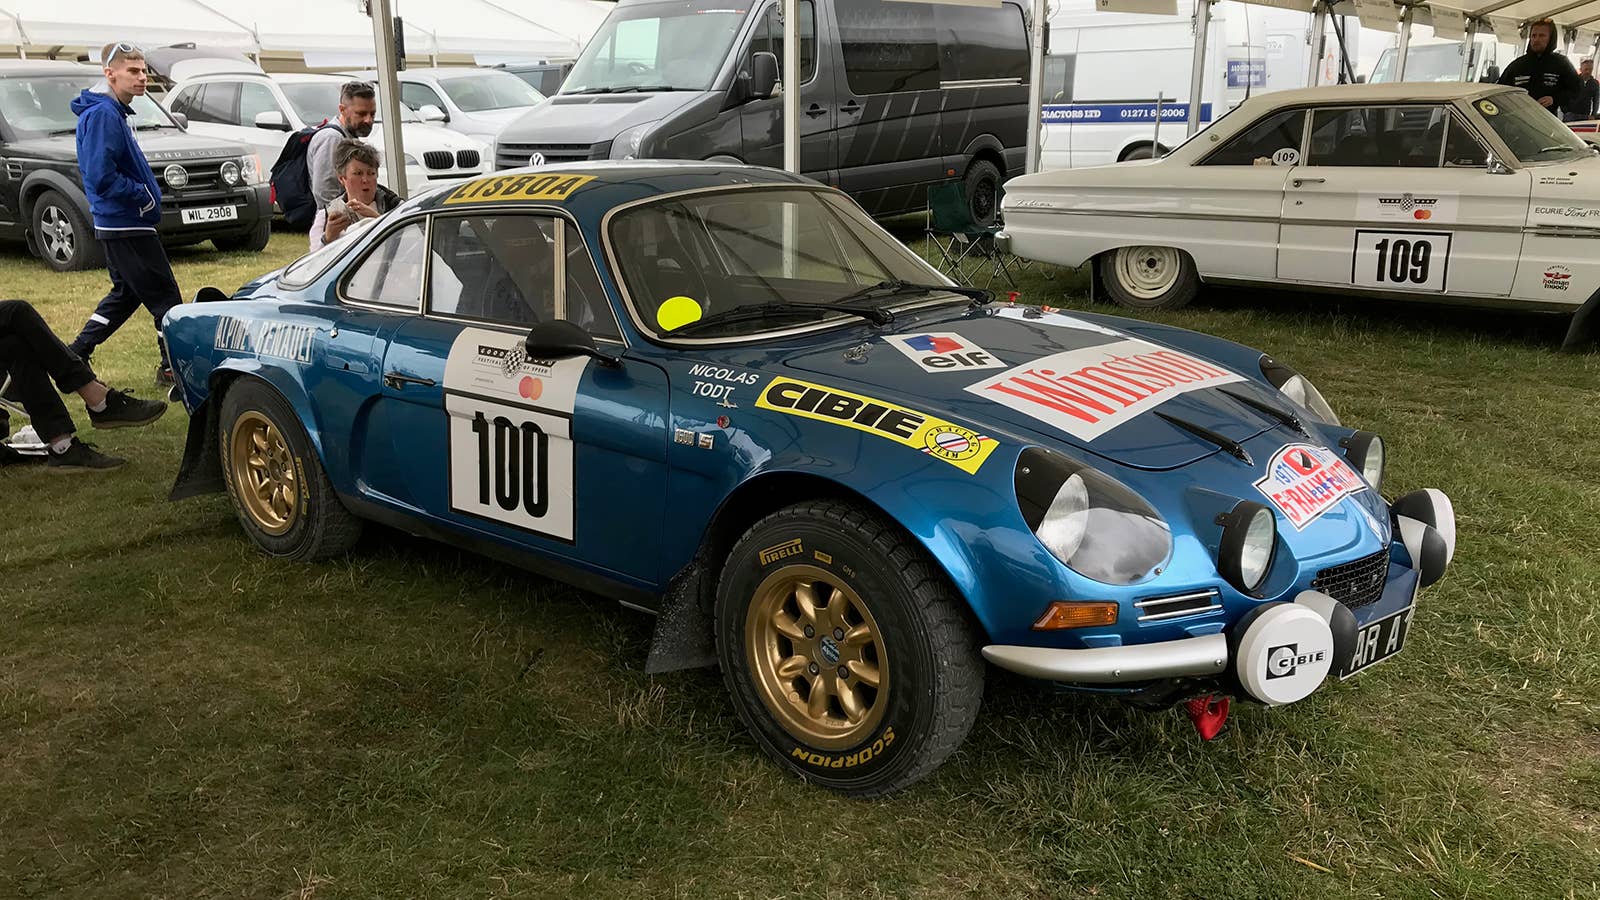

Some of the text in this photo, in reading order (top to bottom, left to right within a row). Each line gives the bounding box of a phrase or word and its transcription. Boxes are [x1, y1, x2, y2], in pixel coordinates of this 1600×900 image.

[1120, 110, 1148, 118] 01271
[1150, 109, 1185, 118] 82006
[1277, 152, 1295, 162] 109
[451, 175, 584, 200] LISBOA
[188, 207, 232, 221] WIL 2908
[1535, 207, 1564, 215] ECURIE
[1564, 206, 1589, 217] Ford
[1375, 238, 1432, 284] 109
[215, 316, 315, 362] ALPINE RENAULT
[922, 352, 991, 368] elf
[688, 364, 760, 385] NICOLAS
[692, 381, 736, 400] TODT
[987, 351, 1230, 424] Winston
[936, 427, 978, 448] RACING
[931, 444, 960, 459] TEAM
[471, 410, 550, 519] 100
[1275, 461, 1301, 486] 1971
[759, 538, 804, 567] PIRELLI
[1350, 624, 1382, 672] AR
[1279, 652, 1325, 668] CIBIE
[792, 726, 896, 769] SCORPION
